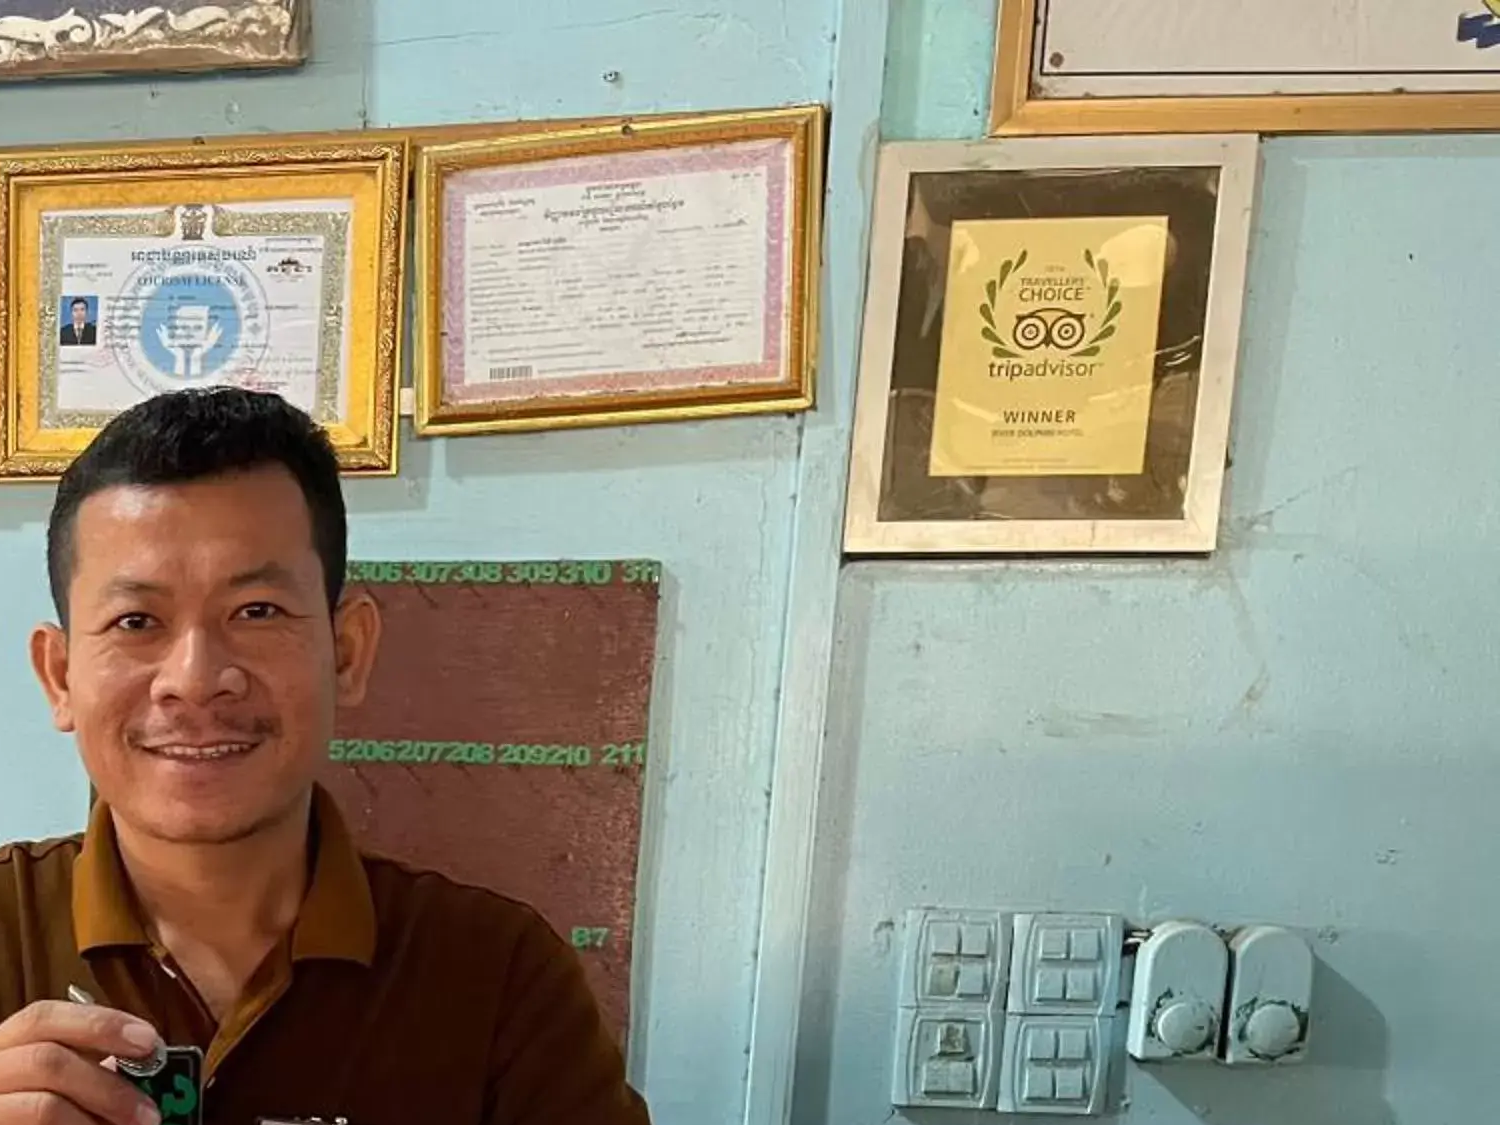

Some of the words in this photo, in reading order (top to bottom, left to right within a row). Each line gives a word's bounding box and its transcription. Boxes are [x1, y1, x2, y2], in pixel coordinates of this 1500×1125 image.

[1018, 287, 1085, 302] CHOICE
[988, 360, 1097, 381] tripadvisor
[1003, 410, 1077, 424] WINNER
[404, 562, 449, 582] 307
[452, 562, 503, 582] 308
[505, 562, 558, 583] 309
[558, 561, 612, 585] 310
[398, 740, 445, 763] 207
[498, 743, 546, 764] 209
[548, 744, 591, 766] 210
[601, 743, 646, 764] 211
